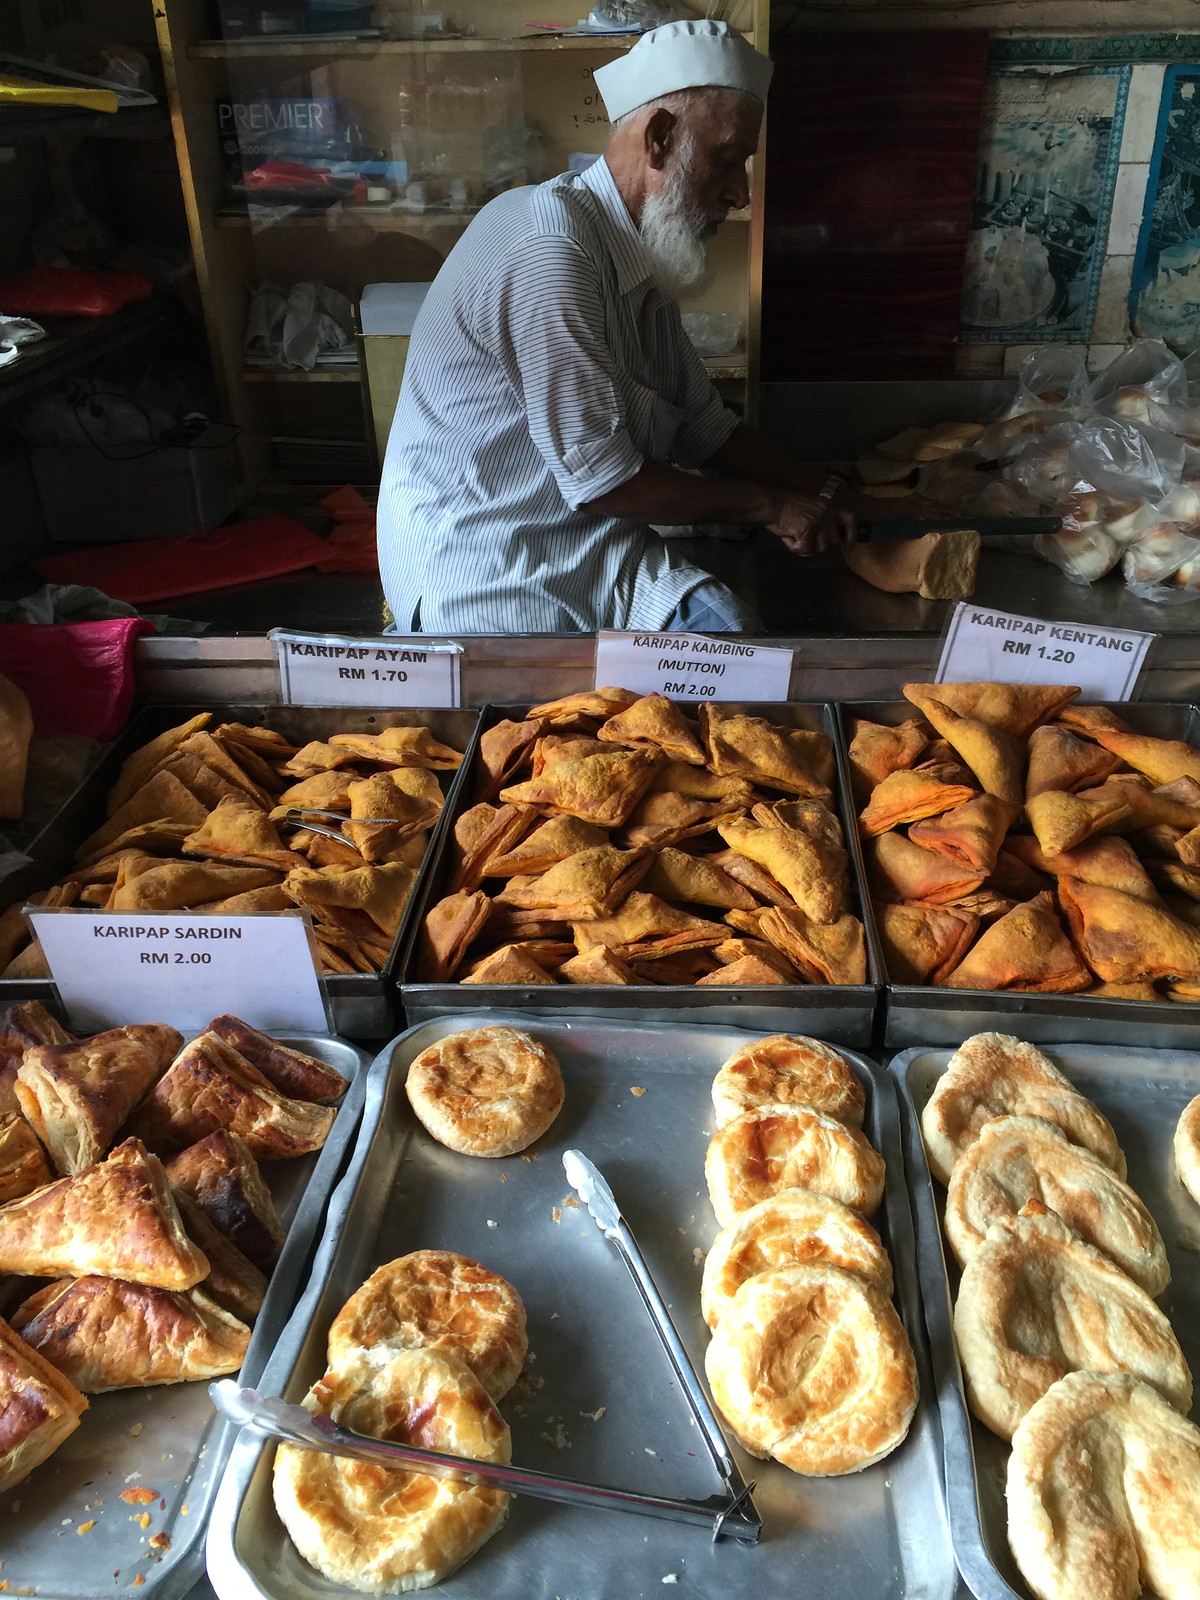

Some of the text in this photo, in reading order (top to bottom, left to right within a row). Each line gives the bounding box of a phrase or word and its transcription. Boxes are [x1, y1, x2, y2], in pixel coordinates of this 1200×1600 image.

[218, 103, 324, 129] PREMIER
[970, 612, 1134, 653] KARIPAP KENTANG
[290, 643, 428, 664] KARIPAP AYAM
[632, 635, 755, 657] KARIPAP KAMBING
[1002, 640, 1076, 665] RM 1.20
[338, 667, 409, 683] RM 1.70
[657, 658, 727, 677] (MUTTON)
[663, 682, 717, 697] RM 2.00
[93, 926, 243, 940] KARIPAP SARDIN
[140, 952, 213, 964] RM 2.00
